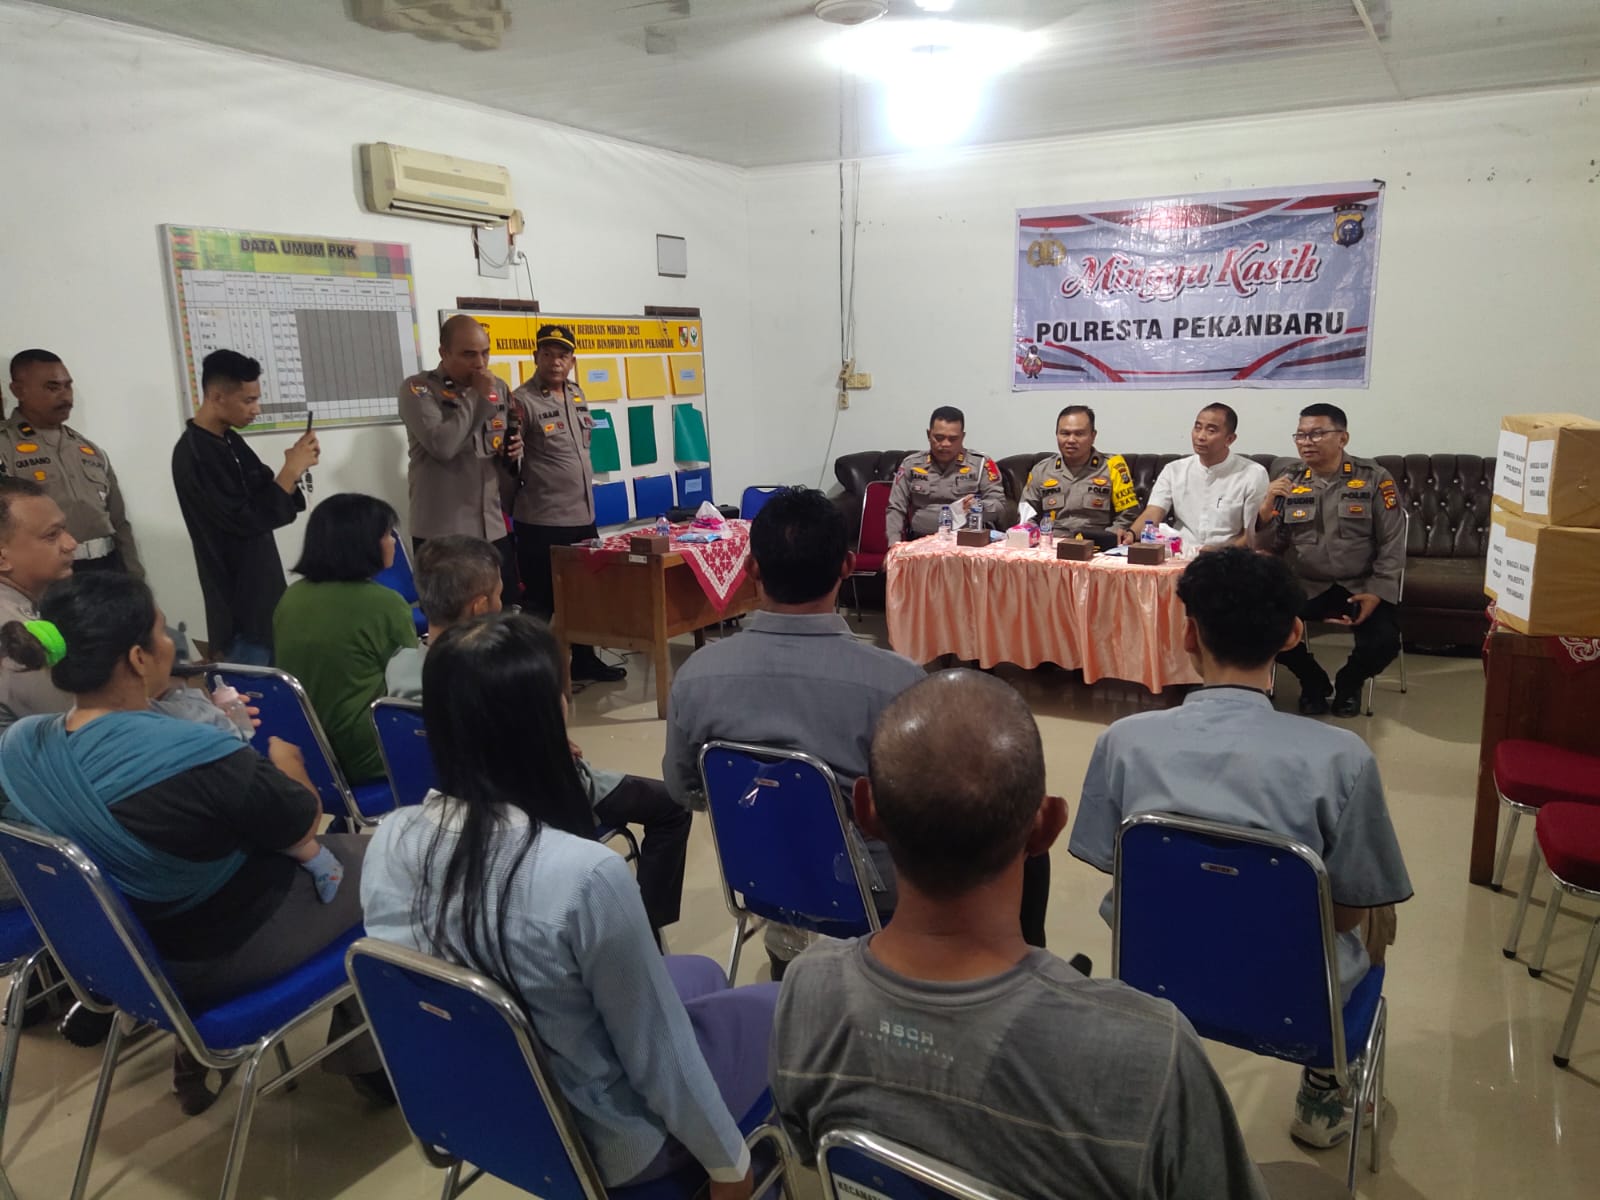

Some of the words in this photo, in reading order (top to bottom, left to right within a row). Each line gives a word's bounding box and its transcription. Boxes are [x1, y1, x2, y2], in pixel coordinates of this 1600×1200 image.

[240, 238, 279, 254] DATA
[280, 240, 325, 257] UMUM
[326, 243, 357, 259] PKK
[1061, 256, 1211, 300] Minggu
[1215, 242, 1319, 294] Kasih
[577, 324, 606, 335] BERBASIS
[607, 325, 626, 335] MIKRO
[1036, 317, 1162, 342] POLRESTA
[1173, 312, 1345, 339] PEKANBARU
[496, 338, 535, 350] KELURAHAN
[629, 338, 644, 349] KOTA
